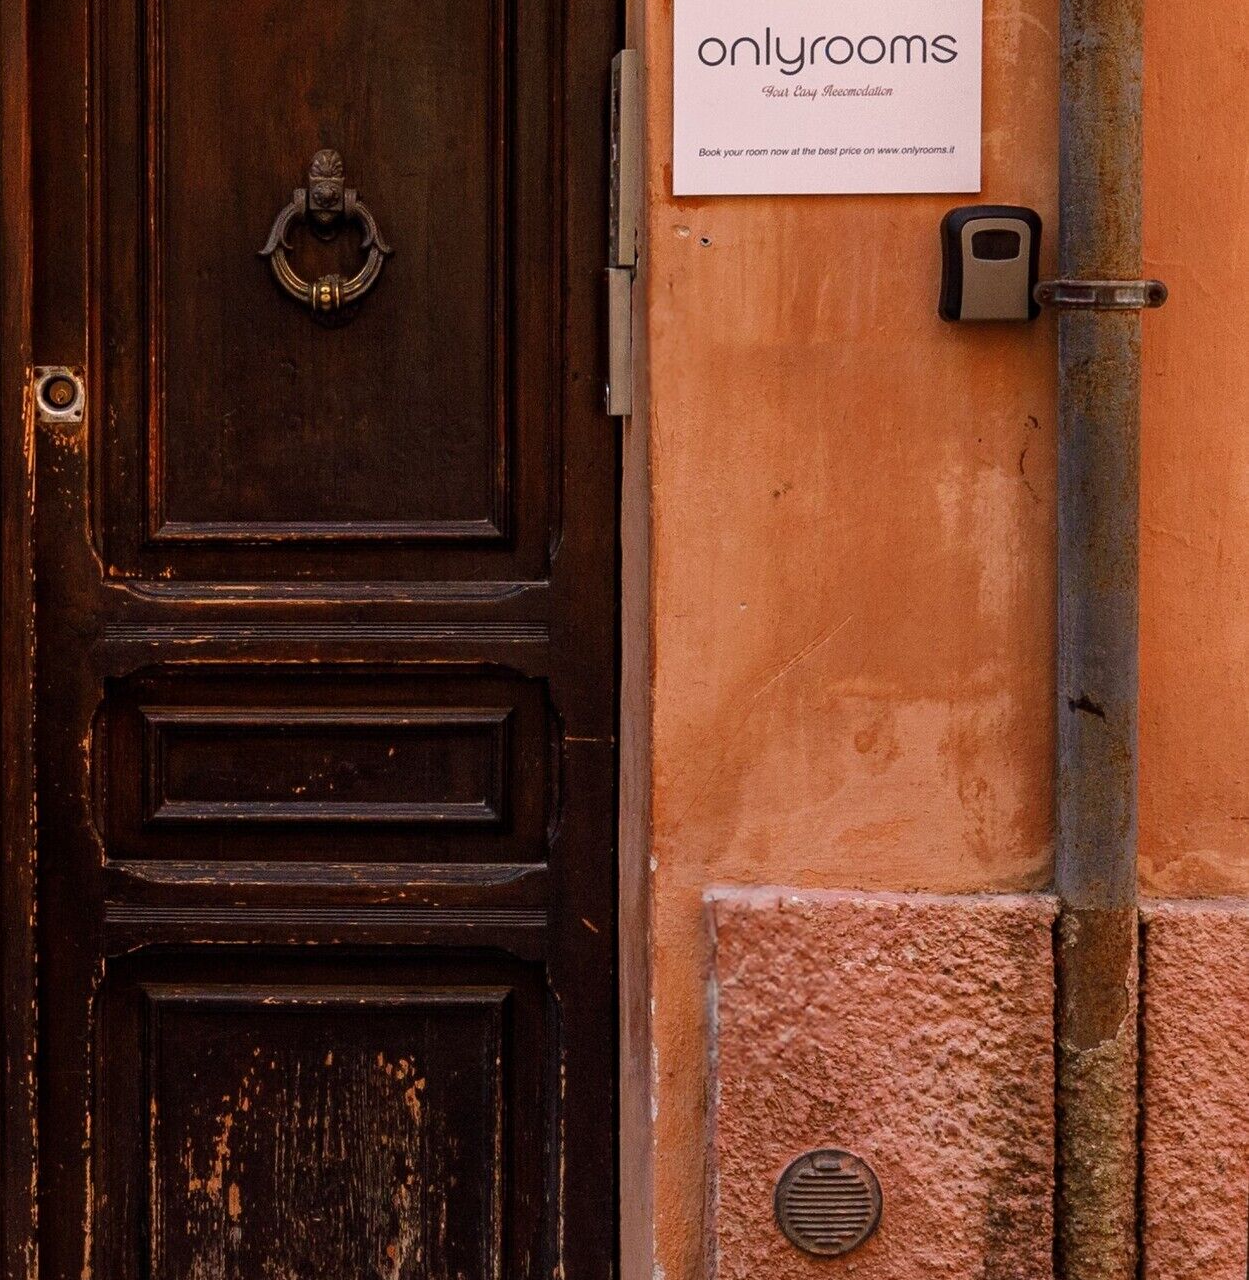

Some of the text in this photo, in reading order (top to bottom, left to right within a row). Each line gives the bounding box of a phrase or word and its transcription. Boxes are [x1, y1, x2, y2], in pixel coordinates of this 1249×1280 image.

[697, 26, 958, 76] onlyrooms
[761, 85, 790, 98] Your
[793, 84, 818, 101] Easy
[698, 145, 955, 159] Book your room now at the best price on www.onlyrooms.it
